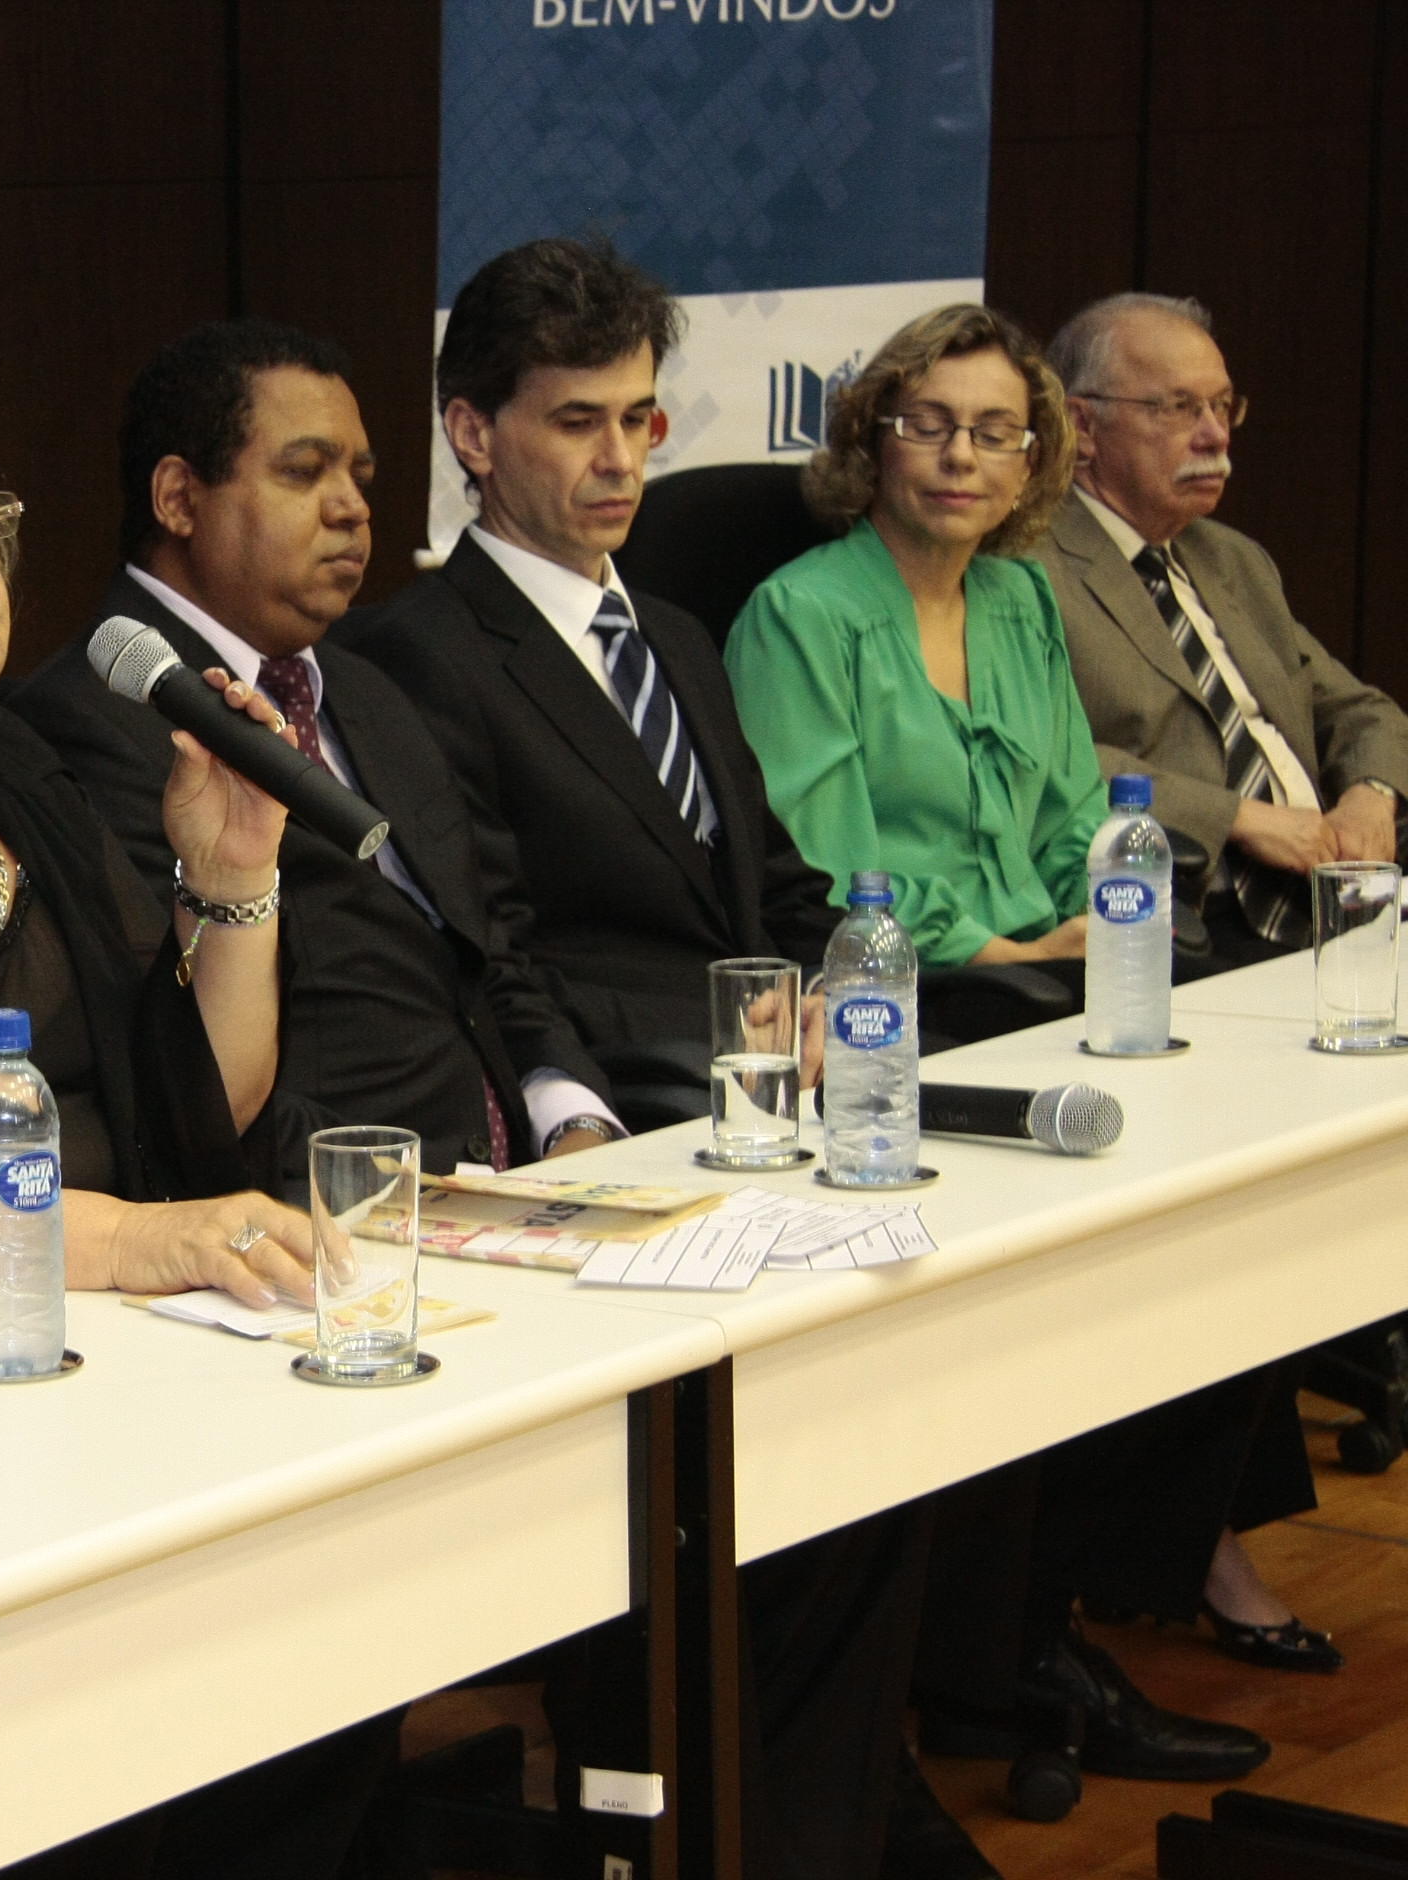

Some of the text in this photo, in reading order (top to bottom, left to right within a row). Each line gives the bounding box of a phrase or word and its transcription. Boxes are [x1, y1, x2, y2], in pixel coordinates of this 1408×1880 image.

[1101, 886, 1144, 902] SANTA
[843, 1007, 891, 1024] SANTA
[7, 1161, 54, 1184] SANTA
[18, 1177, 51, 1197] RITA
